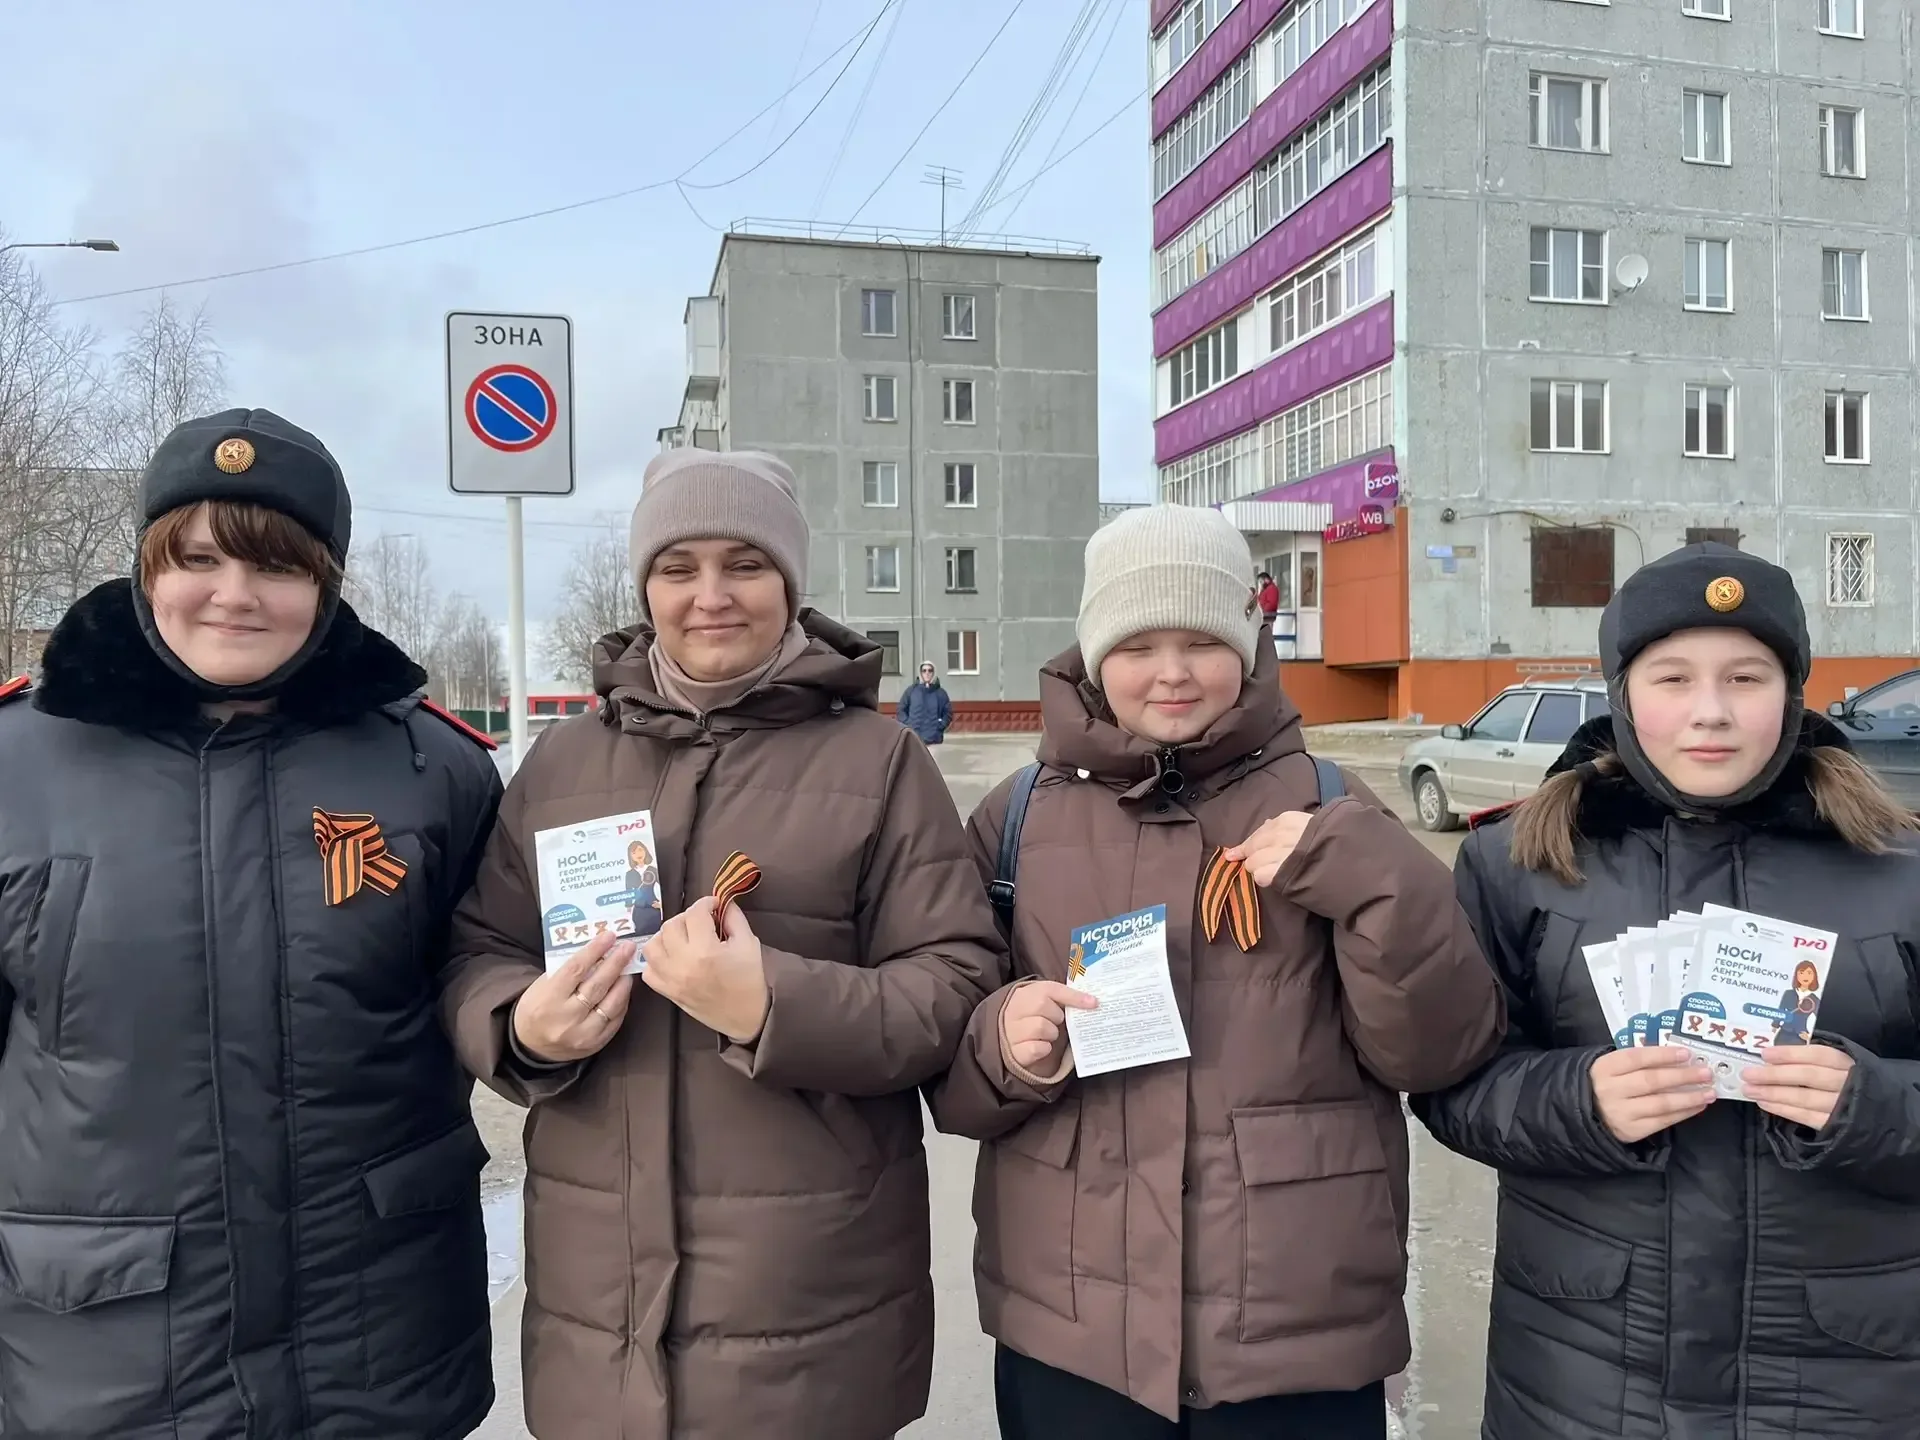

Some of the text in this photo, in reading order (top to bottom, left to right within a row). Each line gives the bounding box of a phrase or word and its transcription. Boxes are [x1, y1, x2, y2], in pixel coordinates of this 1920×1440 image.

[474, 325, 543, 347] ЗОНА
[1361, 511, 1383, 525] WB
[557, 851, 597, 869] НОСИ
[559, 859, 626, 877] ГЕОРГИЕВСКУЮ
[560, 874, 587, 885] ЛЕНТУ
[568, 875, 622, 890] УВАЖЕНИЕМ
[1080, 912, 1153, 945] ИСТОРИЯ
[1717, 943, 1763, 963] НОСИ
[1712, 966, 1744, 979] ЛЕНТУ
[1714, 957, 1789, 981] ГЕОРГИЕВСКУЮ
[1719, 977, 1780, 997] УВАЖЕНИЕМ
